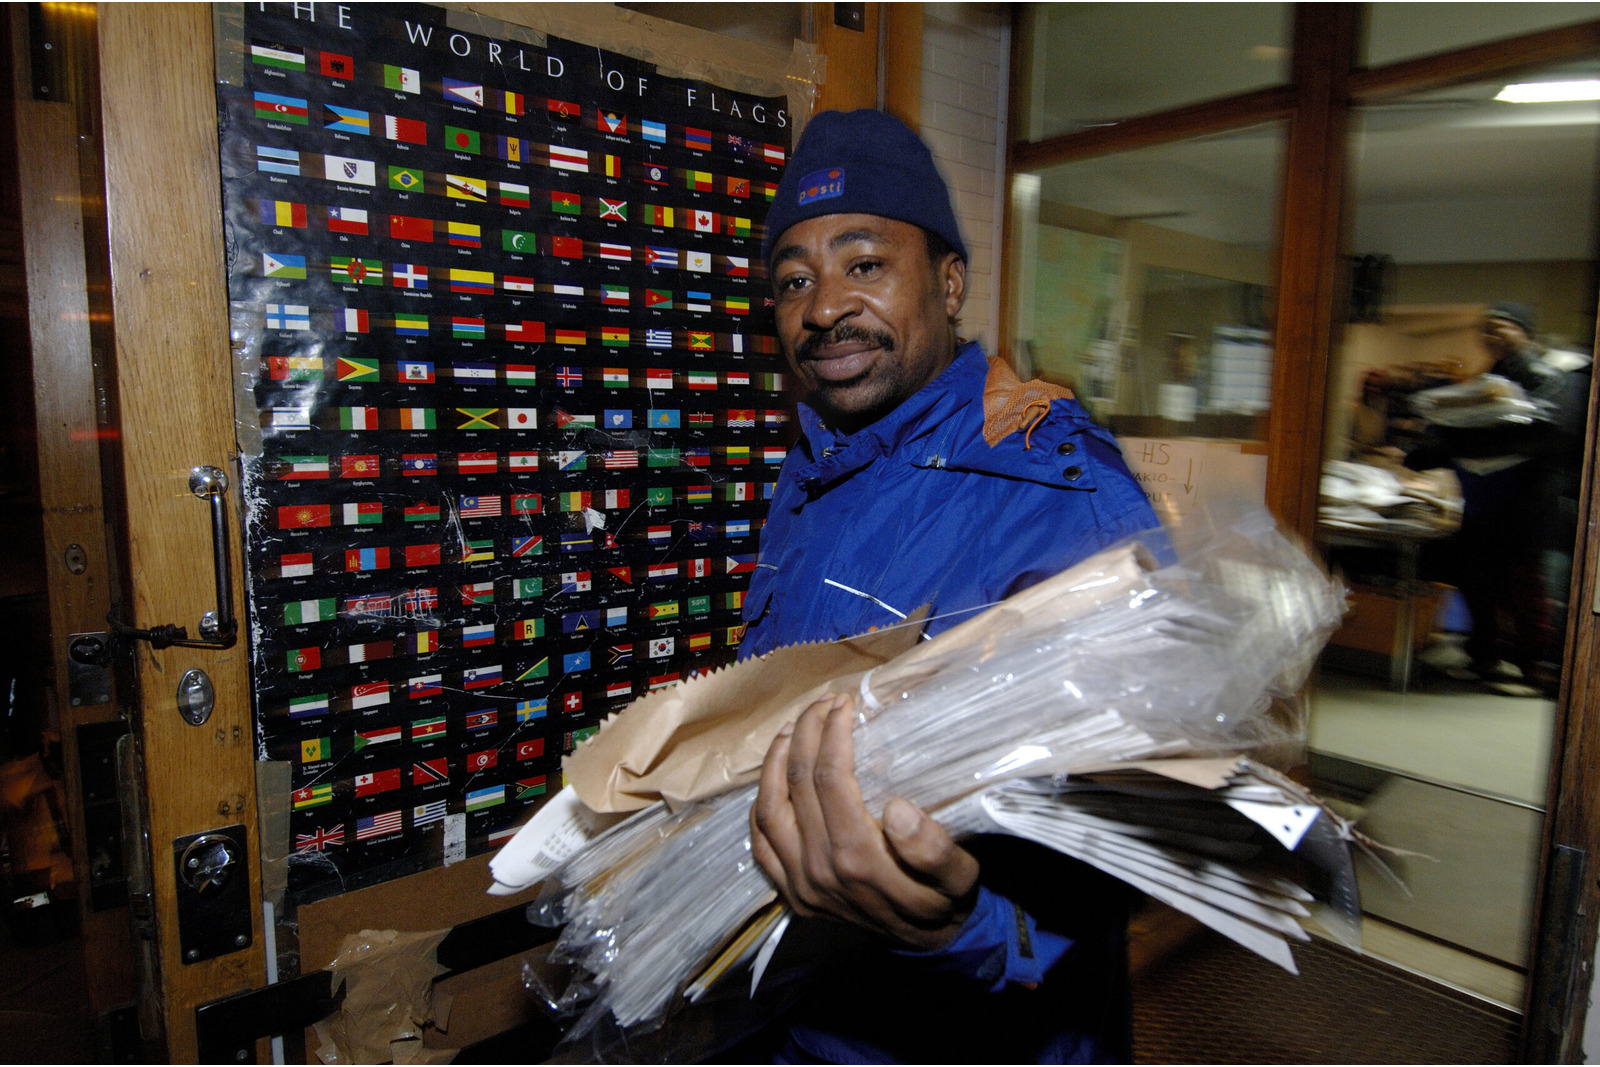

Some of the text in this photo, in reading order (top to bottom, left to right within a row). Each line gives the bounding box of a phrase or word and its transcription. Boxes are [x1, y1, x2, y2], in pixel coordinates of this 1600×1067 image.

[404, 20, 564, 78] WORLD
[606, 70, 648, 97] OF
[687, 88, 787, 128] FLAGS
[799, 181, 841, 203] posti
[1136, 442, 1172, 465] HS
[1132, 472, 1176, 483] AKIO-
